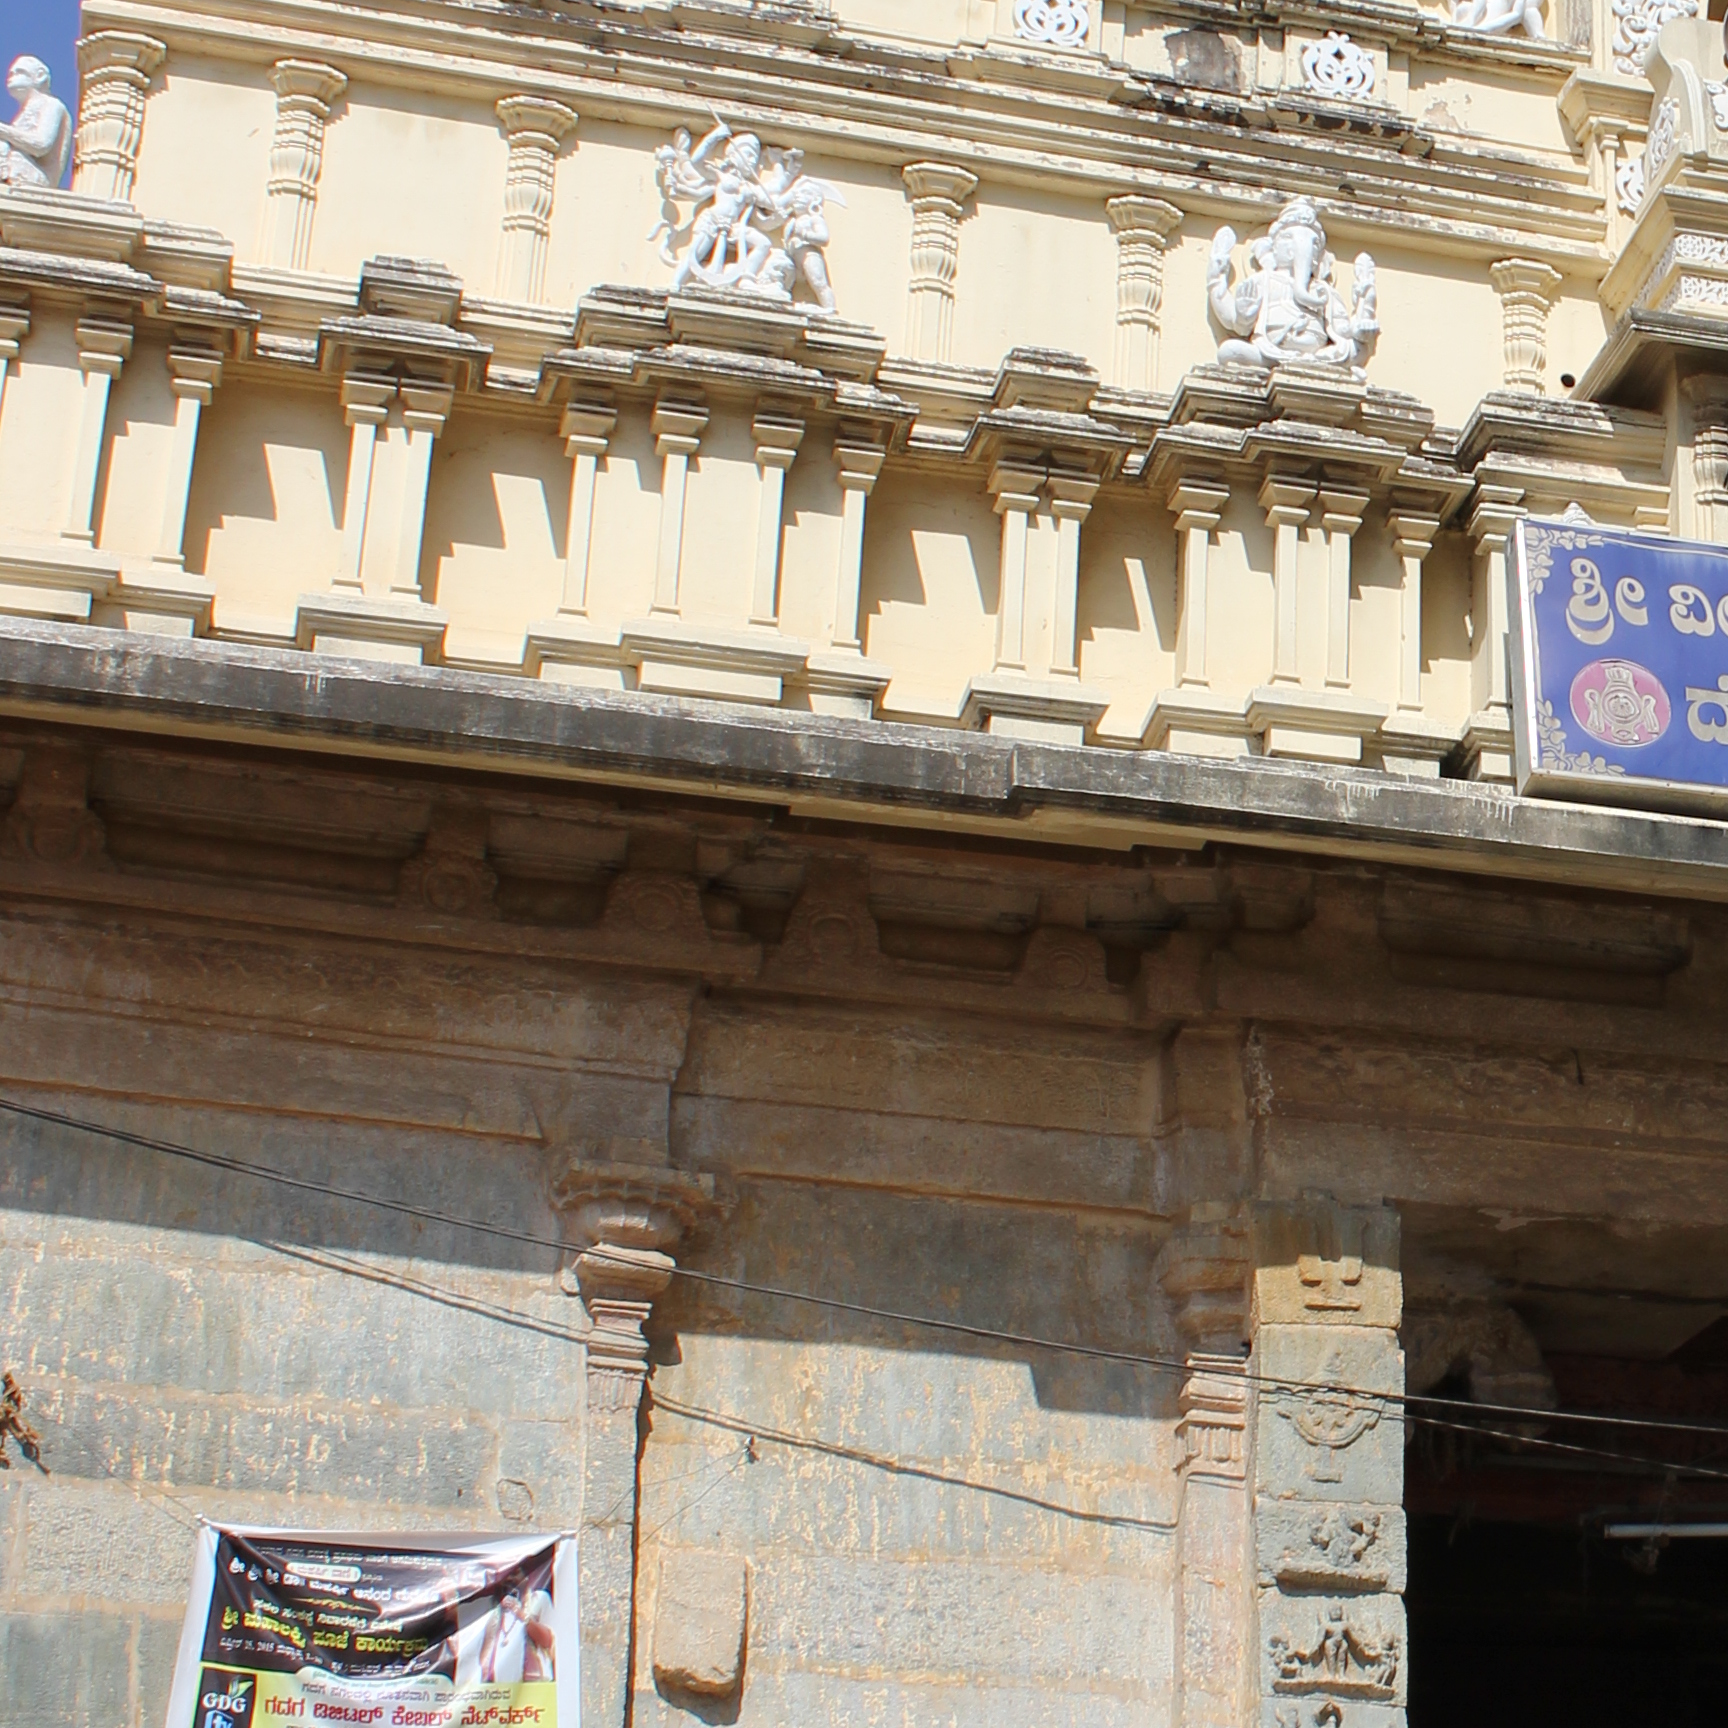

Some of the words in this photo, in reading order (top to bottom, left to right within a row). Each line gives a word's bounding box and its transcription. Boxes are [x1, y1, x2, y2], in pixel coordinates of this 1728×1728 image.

[1565, 557, 1648, 646] ಶ್ರೀ
[203, 1692, 247, 1713] GDG
[264, 1696, 304, 1717] ಗದಗ
[313, 1702, 384, 1724] ಡಿಜಿಟಲ್
[392, 1705, 453, 1726] ಕೇಬಲ್
